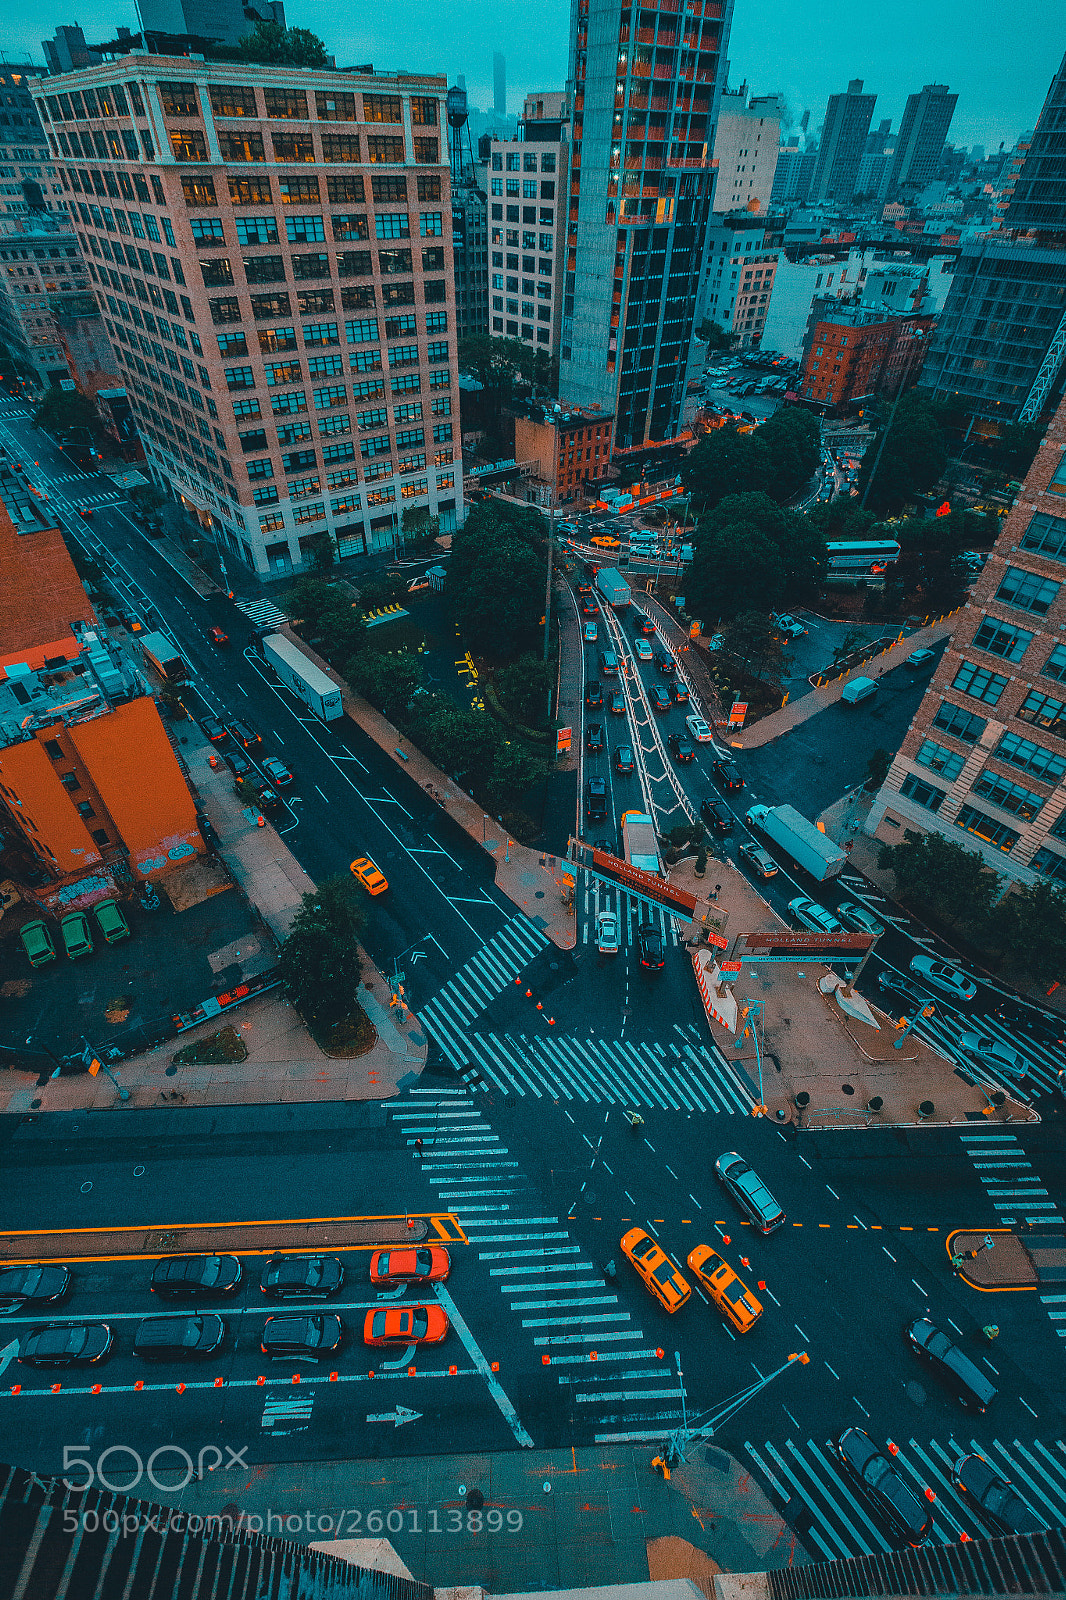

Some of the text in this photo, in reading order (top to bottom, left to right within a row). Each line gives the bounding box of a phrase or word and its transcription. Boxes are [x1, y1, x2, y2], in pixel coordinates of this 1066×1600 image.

[469, 459, 516, 475] HOLLAND TUNNEL
[607, 859, 644, 880] HOLLAND
[647, 878, 680, 897] TUNNEL
